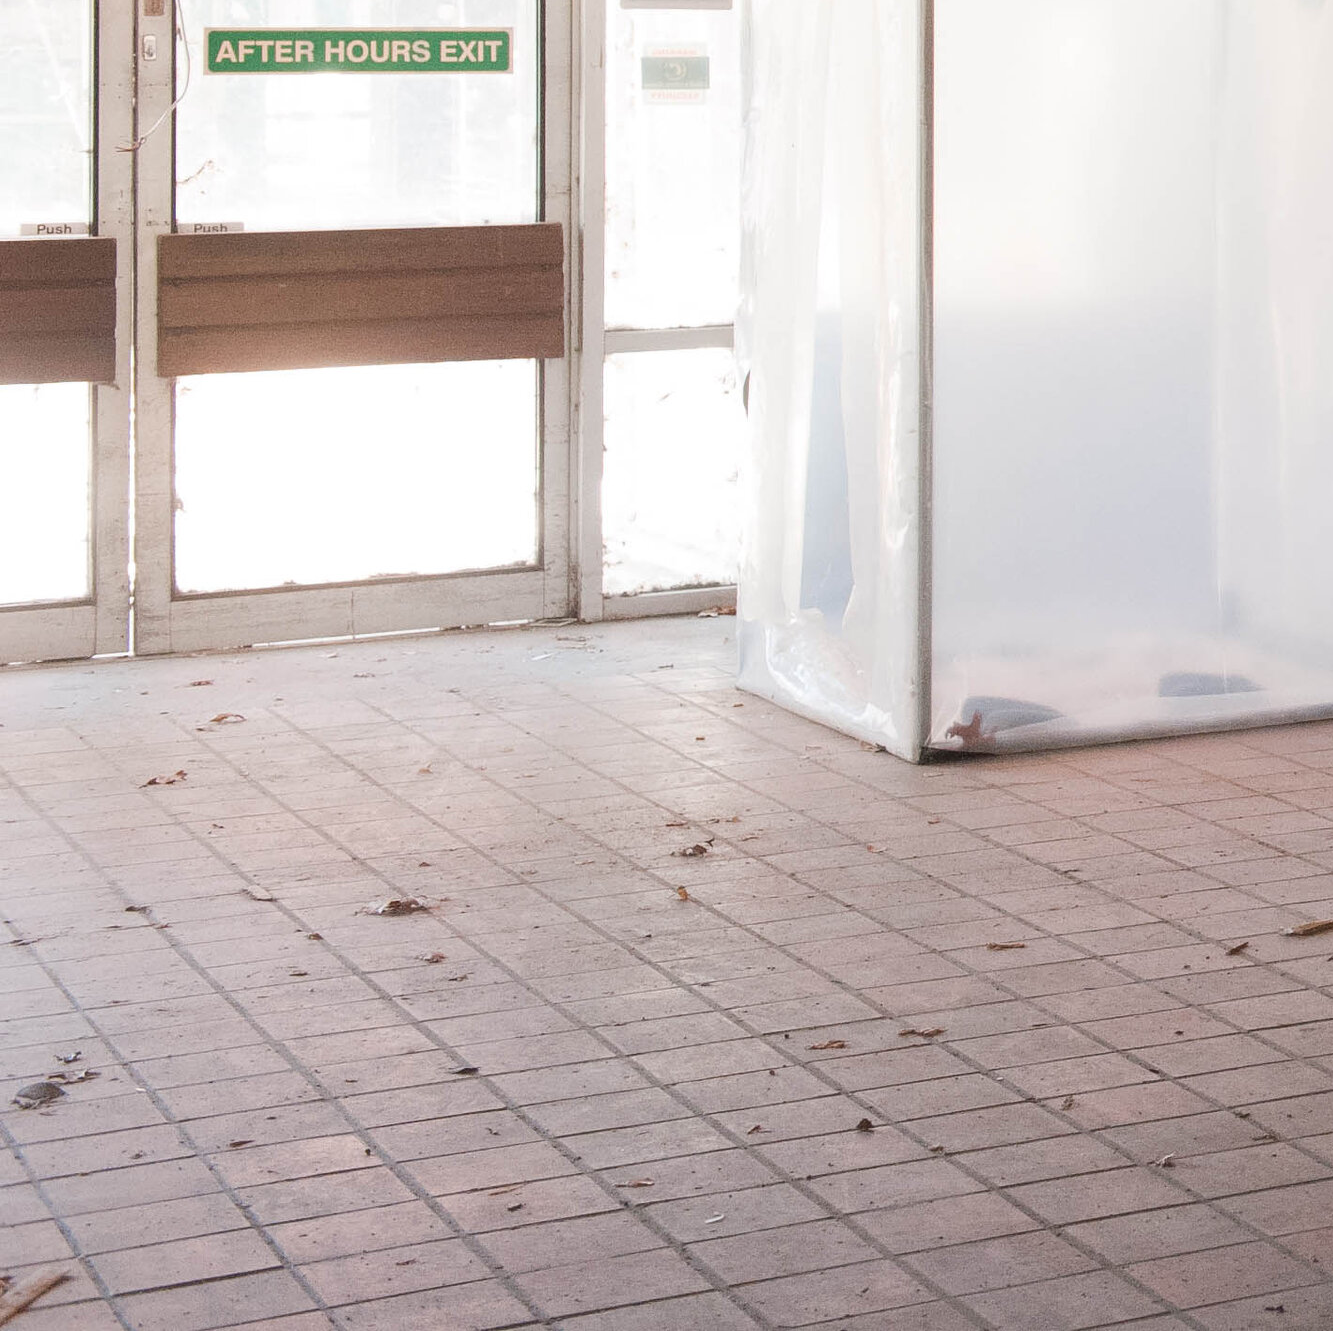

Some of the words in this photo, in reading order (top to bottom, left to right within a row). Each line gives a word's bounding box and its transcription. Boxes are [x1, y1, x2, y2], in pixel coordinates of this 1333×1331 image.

[215, 40, 315, 63] AFTER
[324, 40, 431, 63] HOURS
[439, 40, 503, 63] EXIT
[36, 224, 72, 235] Push
[194, 224, 228, 233] Push
